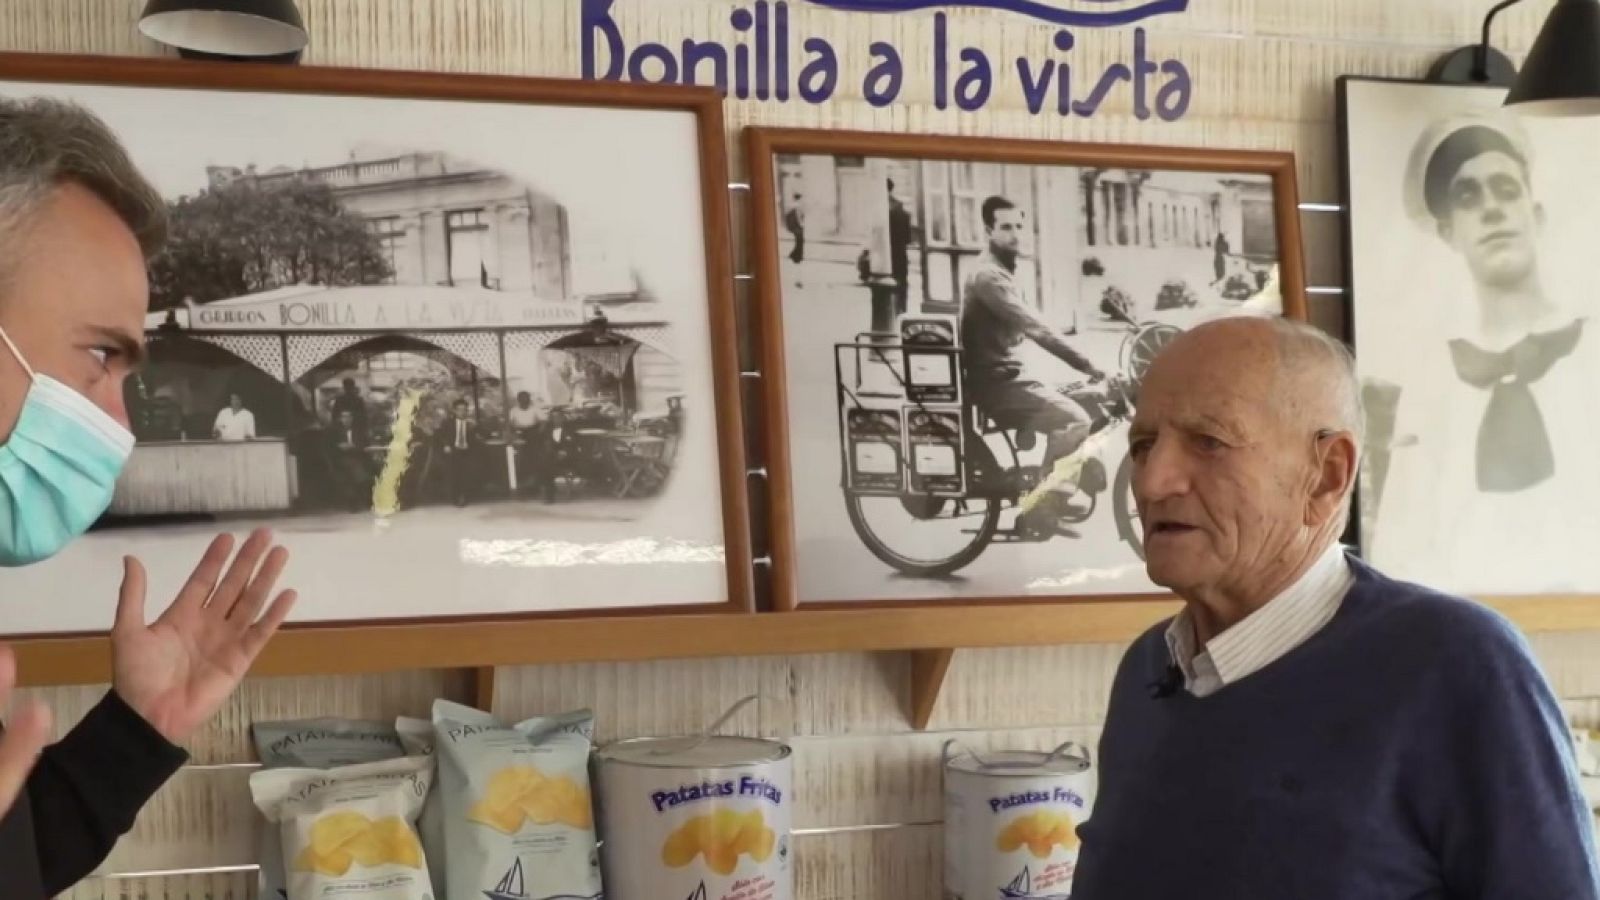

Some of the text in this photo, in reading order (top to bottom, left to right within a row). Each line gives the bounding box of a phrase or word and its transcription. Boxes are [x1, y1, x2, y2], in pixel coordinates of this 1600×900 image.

[581, 0, 1192, 121] Bonilla a la vista
[651, 775, 782, 814] Patatas Fritas
[989, 788, 1050, 814] Patatas
